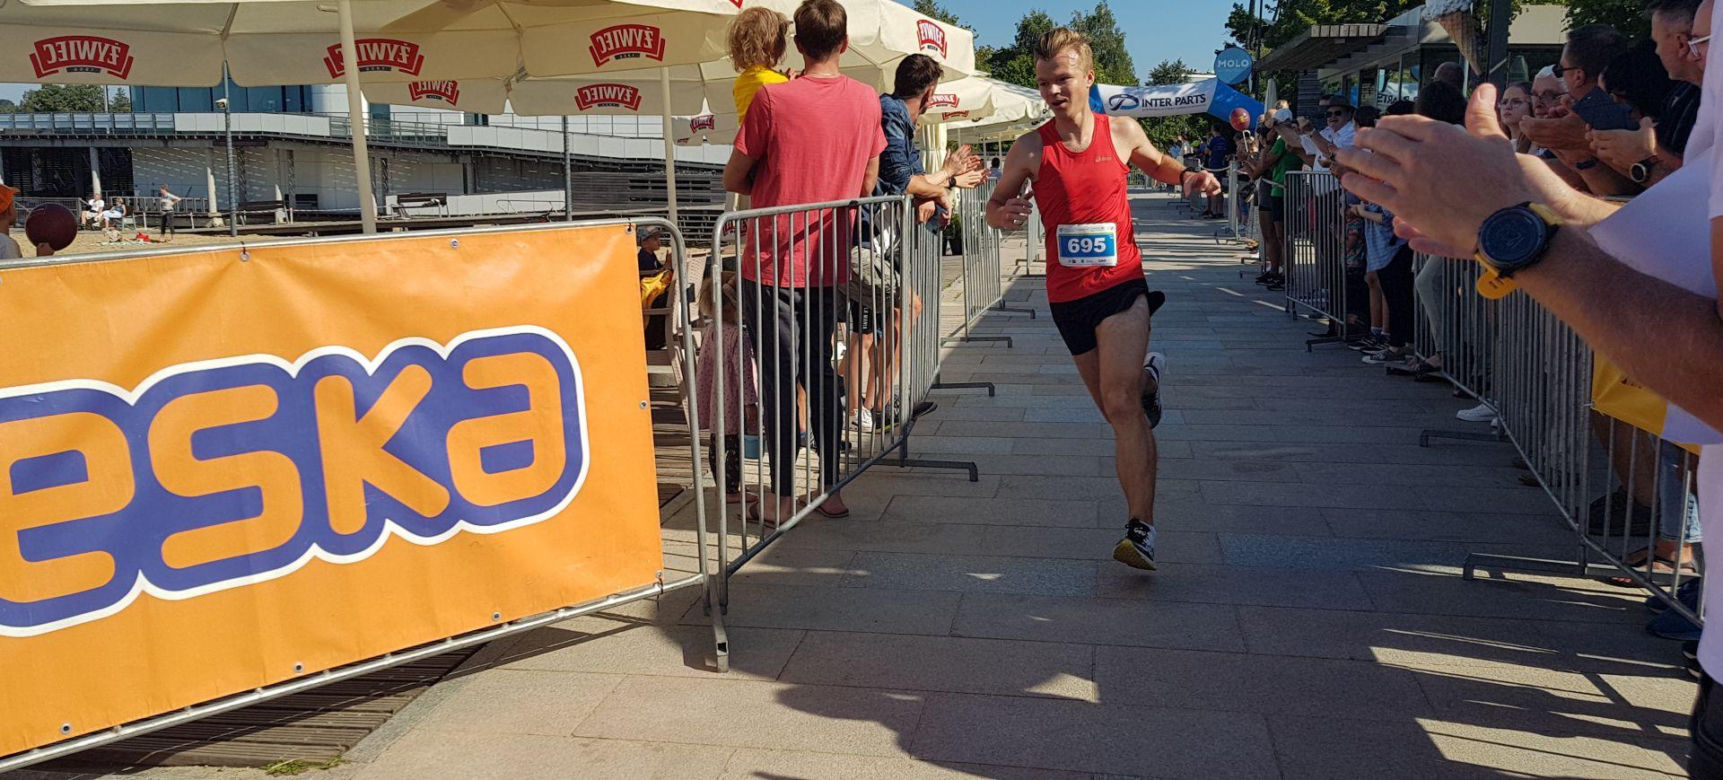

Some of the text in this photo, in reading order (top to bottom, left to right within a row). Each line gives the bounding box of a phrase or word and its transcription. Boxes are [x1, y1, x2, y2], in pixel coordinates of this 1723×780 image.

[1217, 59, 1249, 68] MOLO
[1142, 93, 1206, 107] INTER PARTS
[1067, 237, 1106, 253] 695
[0, 351, 567, 604] eska
